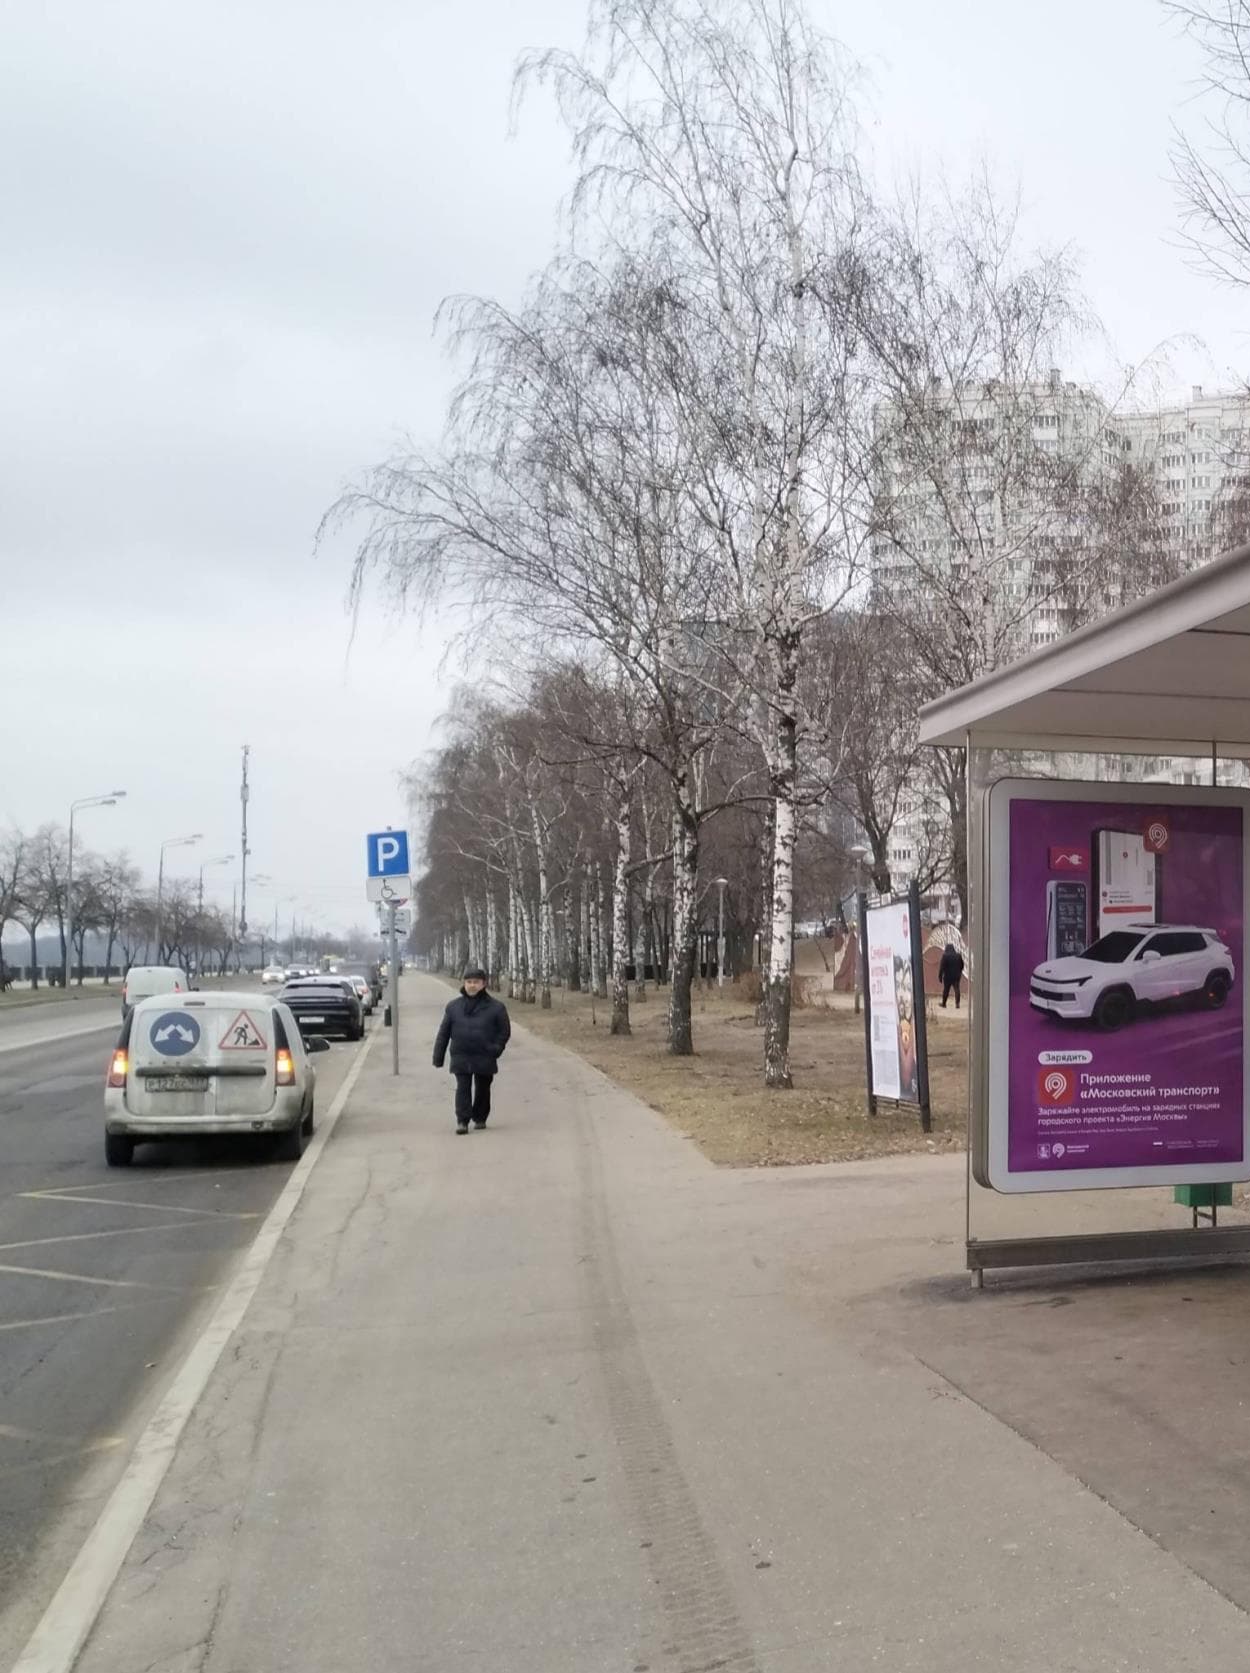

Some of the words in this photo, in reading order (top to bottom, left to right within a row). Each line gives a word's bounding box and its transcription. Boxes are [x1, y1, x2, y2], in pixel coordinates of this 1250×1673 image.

[377, 836, 400, 872] P
[1045, 1053, 1088, 1063] Зарядить
[1080, 1073, 1152, 1086] Приложение
[1080, 1086, 1156, 1099] «Московский
[1158, 1086, 1220, 1099] транспорт»
